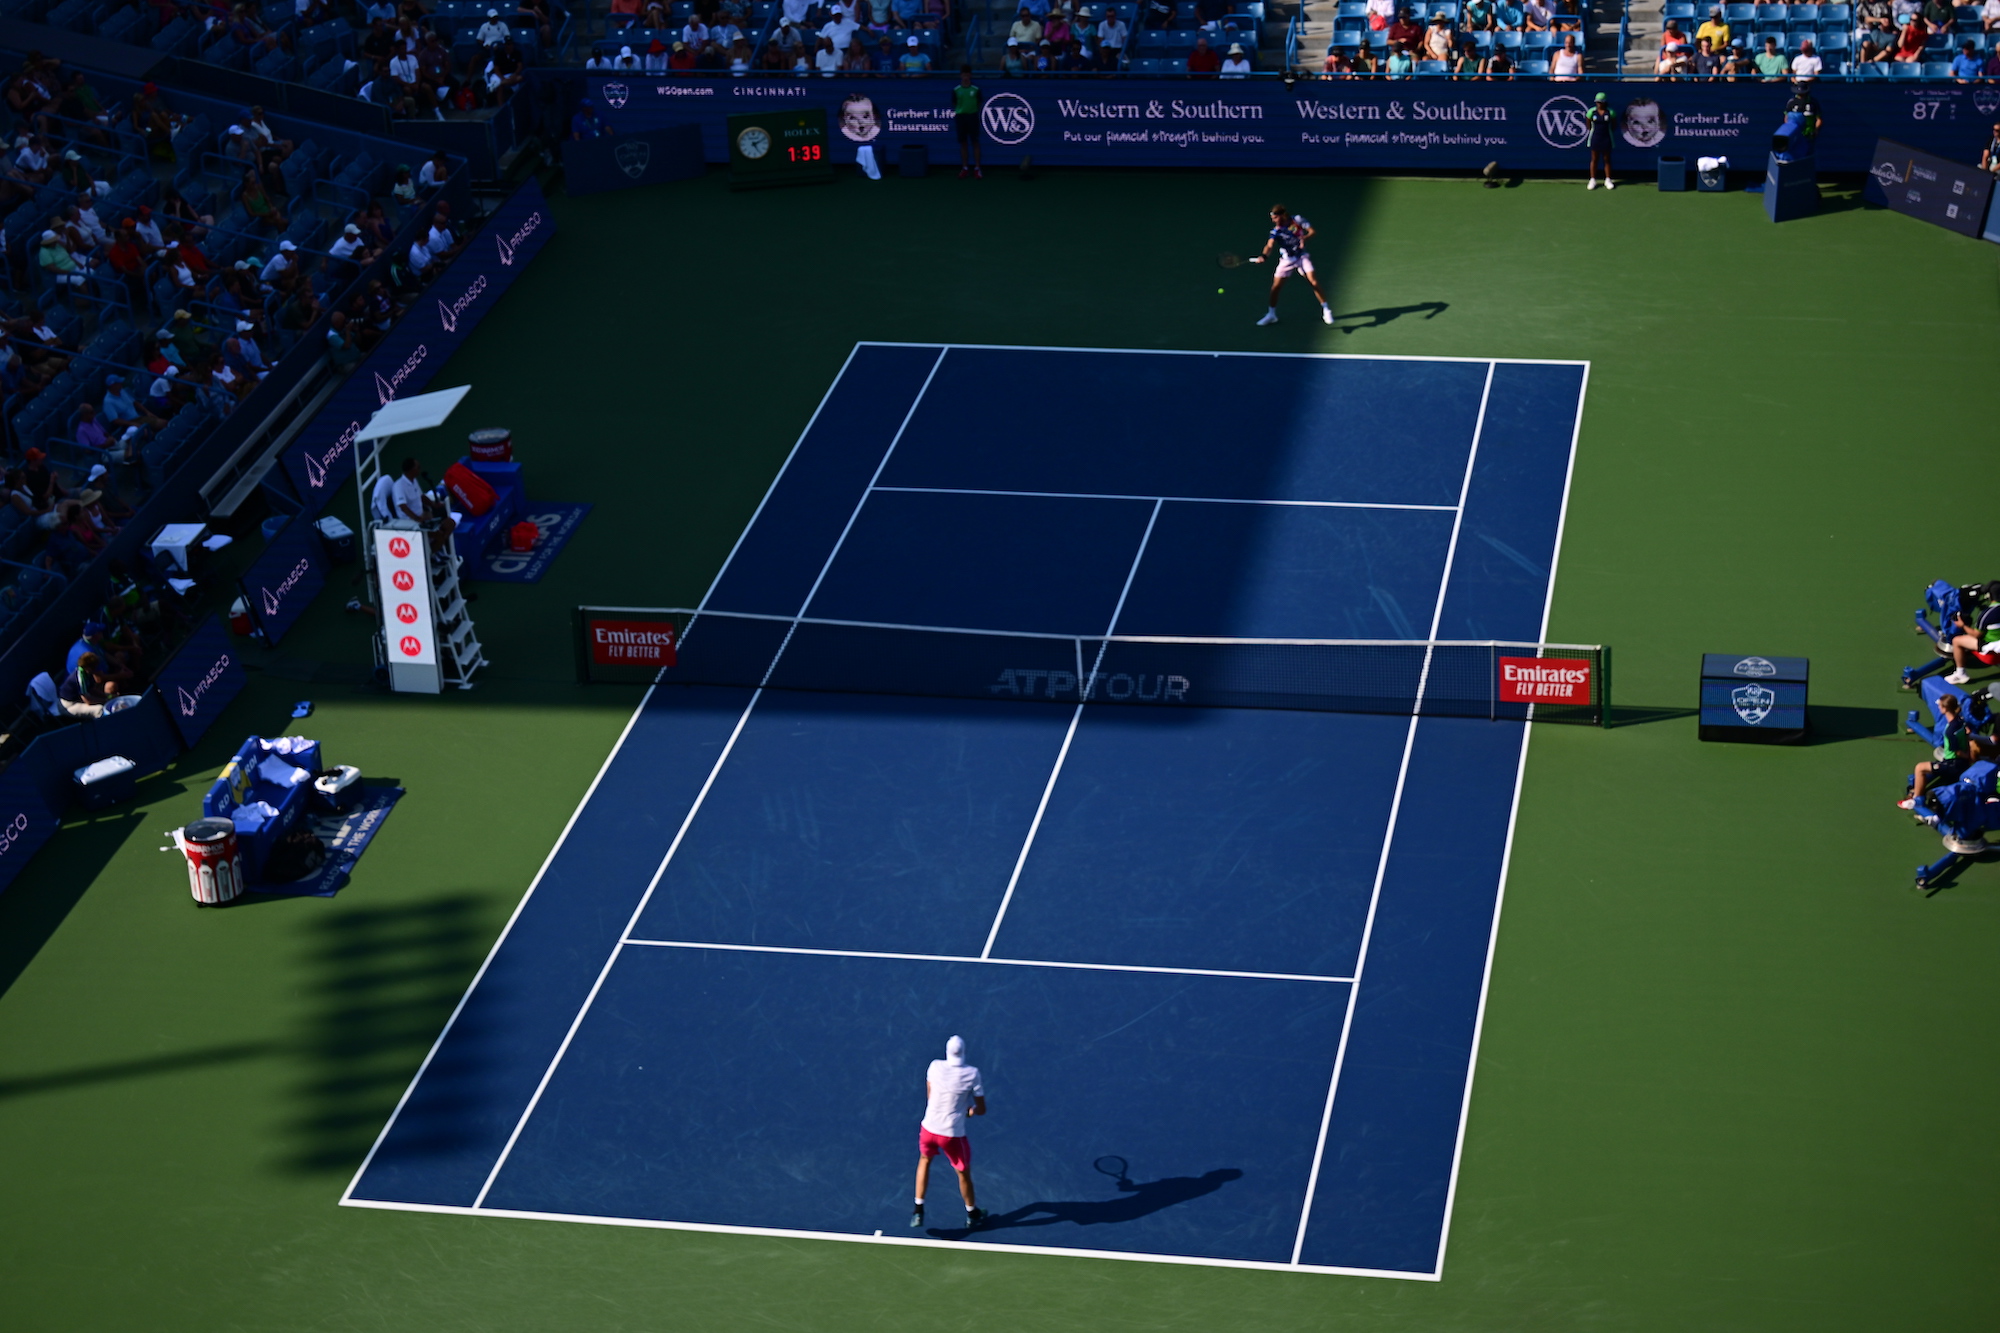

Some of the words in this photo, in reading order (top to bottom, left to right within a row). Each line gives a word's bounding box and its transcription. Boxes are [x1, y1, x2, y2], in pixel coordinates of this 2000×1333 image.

[656, 86, 714, 97] WSOpen.com
[733, 86, 806, 97] CINCINNATI
[886, 107, 930, 119] Gerber
[1057, 99, 1139, 119] Western
[1145, 100, 1165, 119] &
[1171, 99, 1264, 120] Southern
[1295, 100, 1381, 120] Western
[1386, 101, 1406, 120] &
[1412, 100, 1507, 121] Southern
[1673, 112, 1720, 124] Gerber
[1723, 112, 1749, 124] Life
[1912, 101, 1940, 120] 87
[887, 120, 950, 132] Insurance
[984, 106, 1030, 134] W&S
[784, 127, 821, 138] ROLEX
[1063, 131, 1082, 142] Put
[1084, 133, 1102, 142] our
[1106, 129, 1149, 147] financial
[1152, 130, 1200, 148] strength
[1202, 131, 1239, 143] behind
[1241, 134, 1265, 144] you.
[1302, 132, 1320, 144] Put
[1322, 134, 1340, 144] our
[1345, 131, 1389, 148] financial
[1391, 131, 1441, 149] strength
[1443, 133, 1482, 145] behind
[1484, 136, 1508, 147] you.
[1673, 125, 1740, 137] Insurance
[787, 145, 822, 162] 1:39
[509, 211, 542, 251] PRASCO
[452, 274, 488, 317] PRASCO
[390, 344, 428, 390] PRASCO
[321, 420, 361, 470] PRASCO
[275, 558, 309, 600] PRASCO
[595, 628, 671, 646] Emirates
[608, 644, 625, 658] FLY
[626, 645, 661, 659] BETTER
[193, 654, 231, 699] PRASCO
[1503, 664, 1586, 684] Emirates
[988, 668, 1077, 698] ATP
[1083, 671, 1190, 701] TOUR
[1516, 682, 1535, 696] FLY
[1536, 683, 1574, 697] BETTER
[0, 812, 28, 856] SCO
